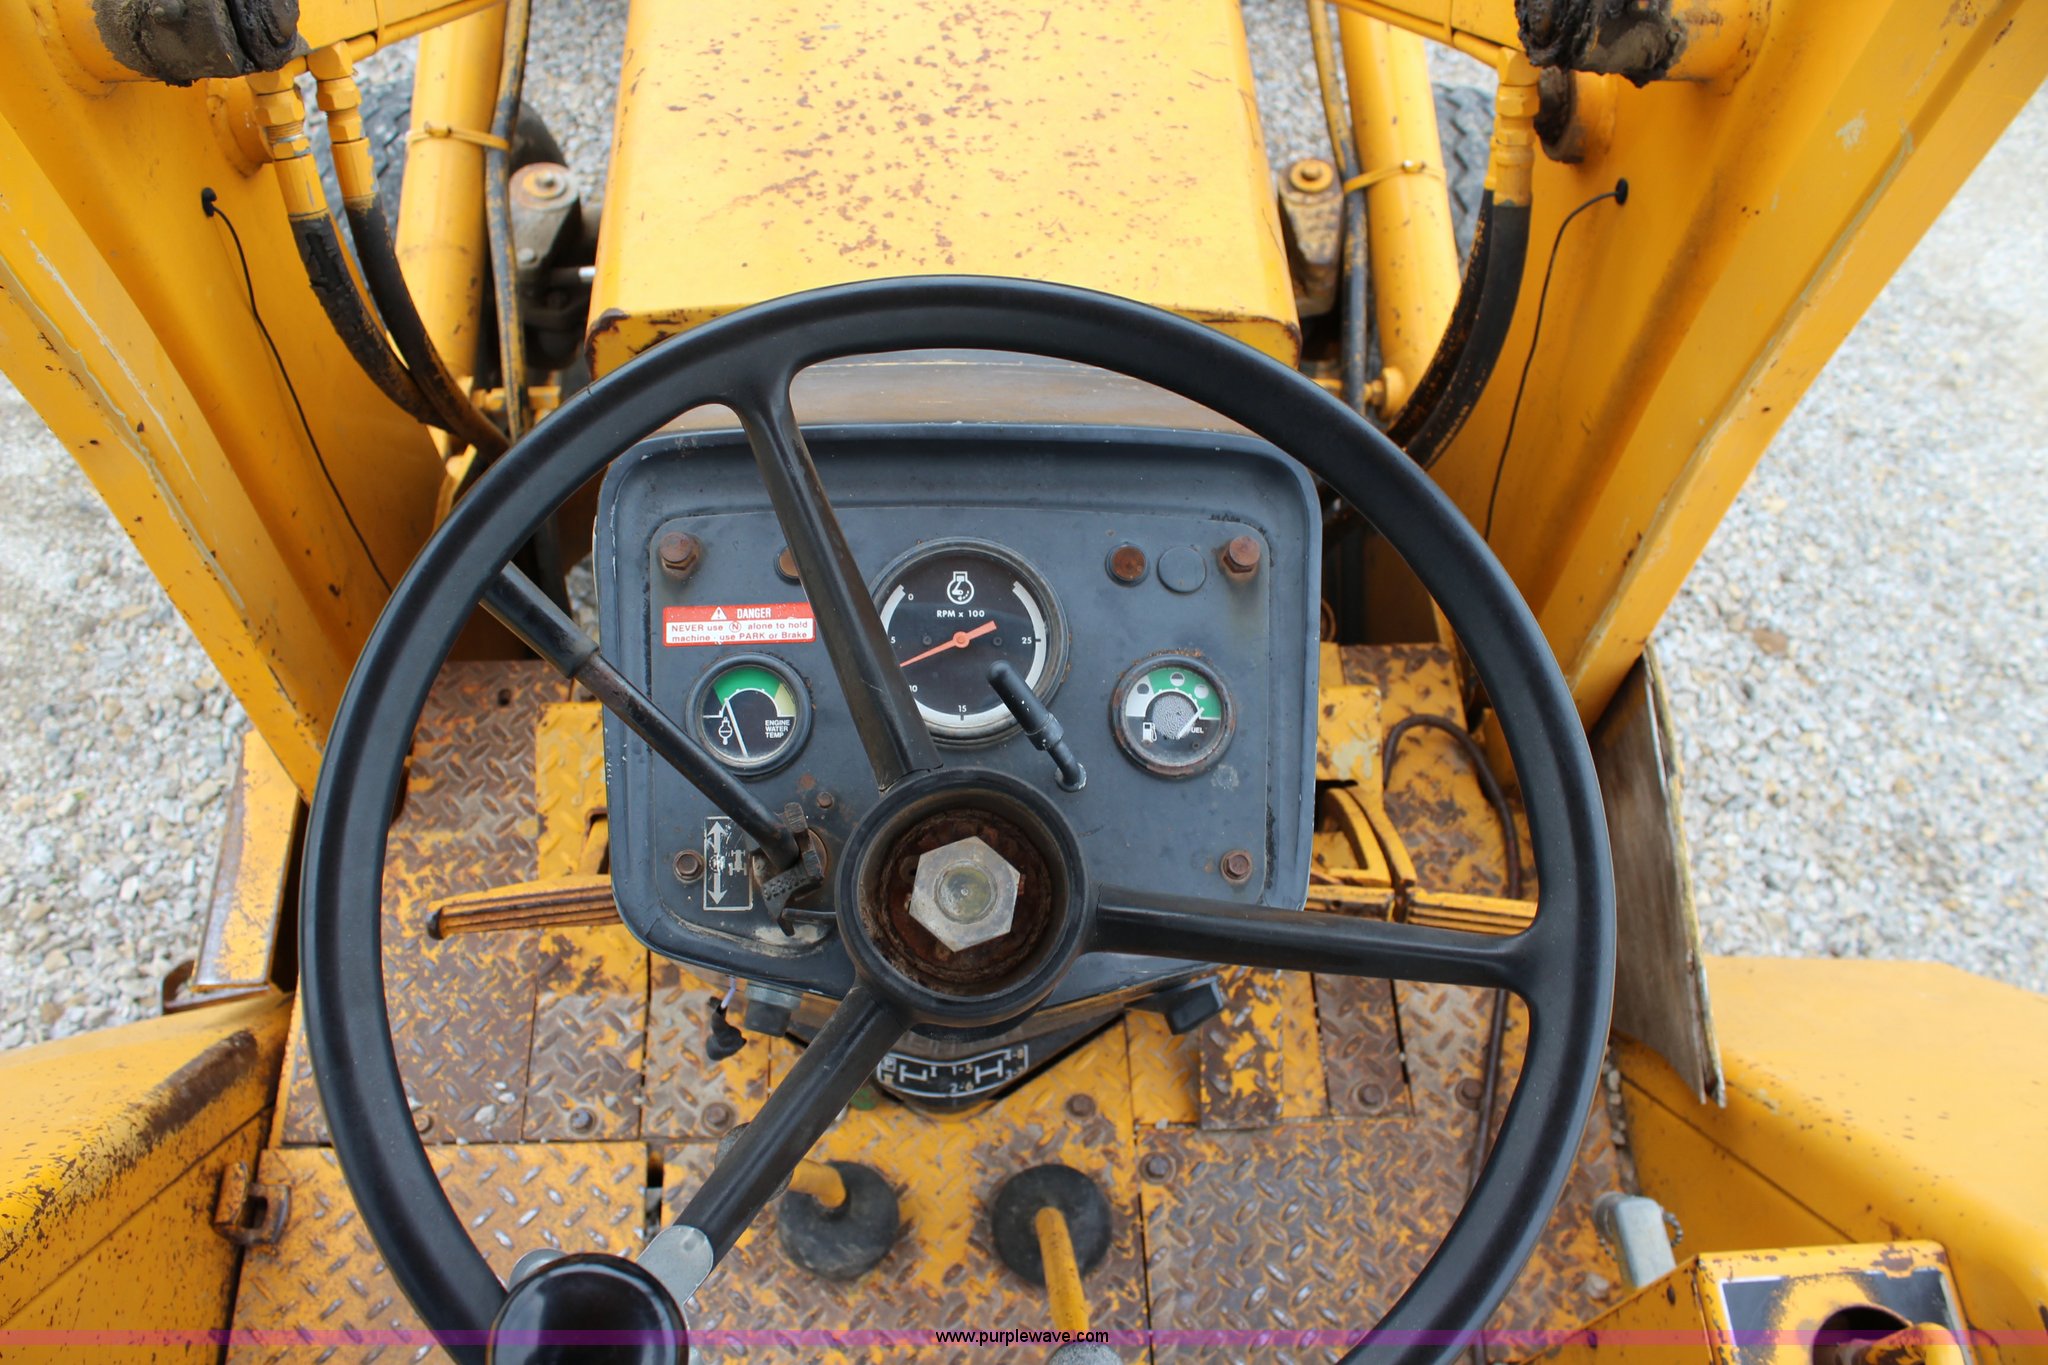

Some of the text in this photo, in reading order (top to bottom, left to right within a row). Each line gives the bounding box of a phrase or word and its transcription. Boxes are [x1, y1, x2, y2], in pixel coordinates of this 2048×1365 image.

[907, 593, 914, 601] 0
[736, 607, 772, 619] DANGER
[936, 609, 956, 618] RPM
[968, 609, 985, 618] 100
[671, 624, 704, 632] NEVER
[748, 622, 773, 630] alone
[672, 634, 711, 642] machine
[739, 632, 766, 640] PARK
[781, 631, 807, 639] Brake
[1021, 636, 1032, 645] 25
[958, 705, 967, 713] 15
